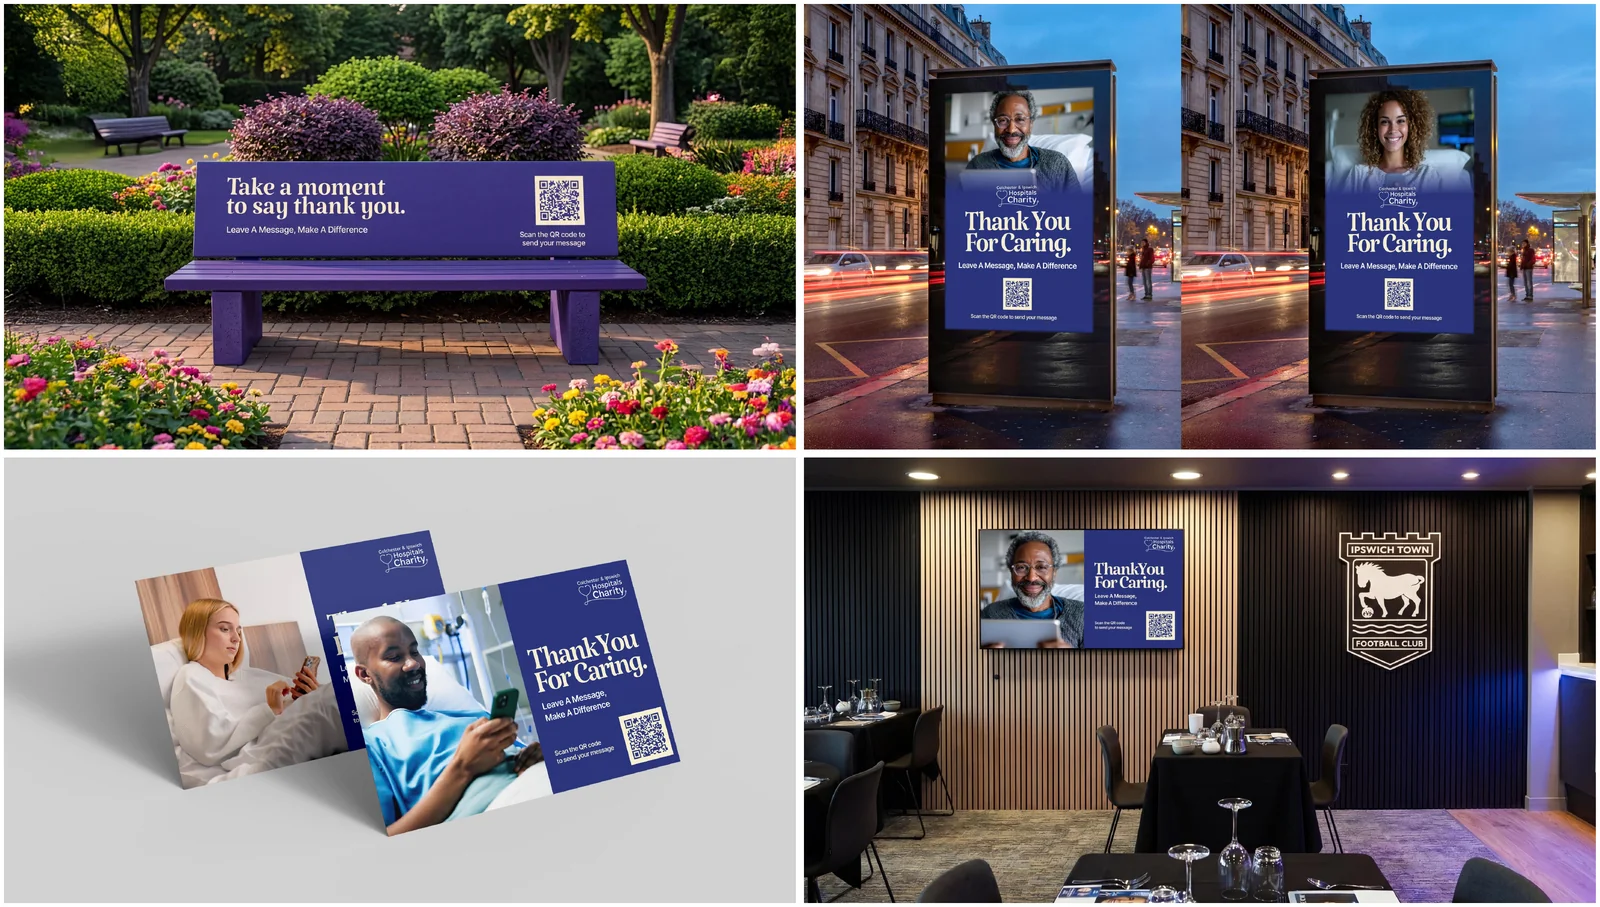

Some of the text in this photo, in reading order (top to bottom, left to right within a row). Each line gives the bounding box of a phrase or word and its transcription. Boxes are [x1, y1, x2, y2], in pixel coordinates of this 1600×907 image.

[226, 176, 386, 196] Take a moment
[226, 196, 406, 220] to say thank you.
[1007, 196, 1037, 205] Charity
[1388, 197, 1416, 206] Charity
[964, 210, 1072, 231] Thank You
[1346, 212, 1452, 232] Thank You
[226, 226, 250, 234] Leave
[250, 226, 258, 234] A
[258, 226, 296, 236] Message,
[298, 226, 319, 234] Make
[328, 226, 368, 234] Difference
[965, 232, 1071, 258] For Caring.
[1347, 233, 1452, 259] For Caring.
[984, 262, 1016, 271] Message,
[1366, 263, 1397, 271] Message,
[393, 548, 424, 558] Hospitals
[1351, 546, 1429, 554] IPSWICH TOWN
[394, 556, 426, 567] Charity
[592, 579, 622, 590] Hospitals
[1095, 576, 1168, 592] For Caring.
[592, 587, 624, 599] Charity
[534, 655, 648, 693] For Caring.
[542, 698, 564, 710] Leave
[572, 690, 607, 704] Message,
[545, 701, 611, 722] Make A Difference
[554, 748, 568, 756] Scan
[588, 740, 601, 748] code
[563, 754, 577, 763] send
[577, 751, 590, 761] your
[590, 745, 614, 756] message
